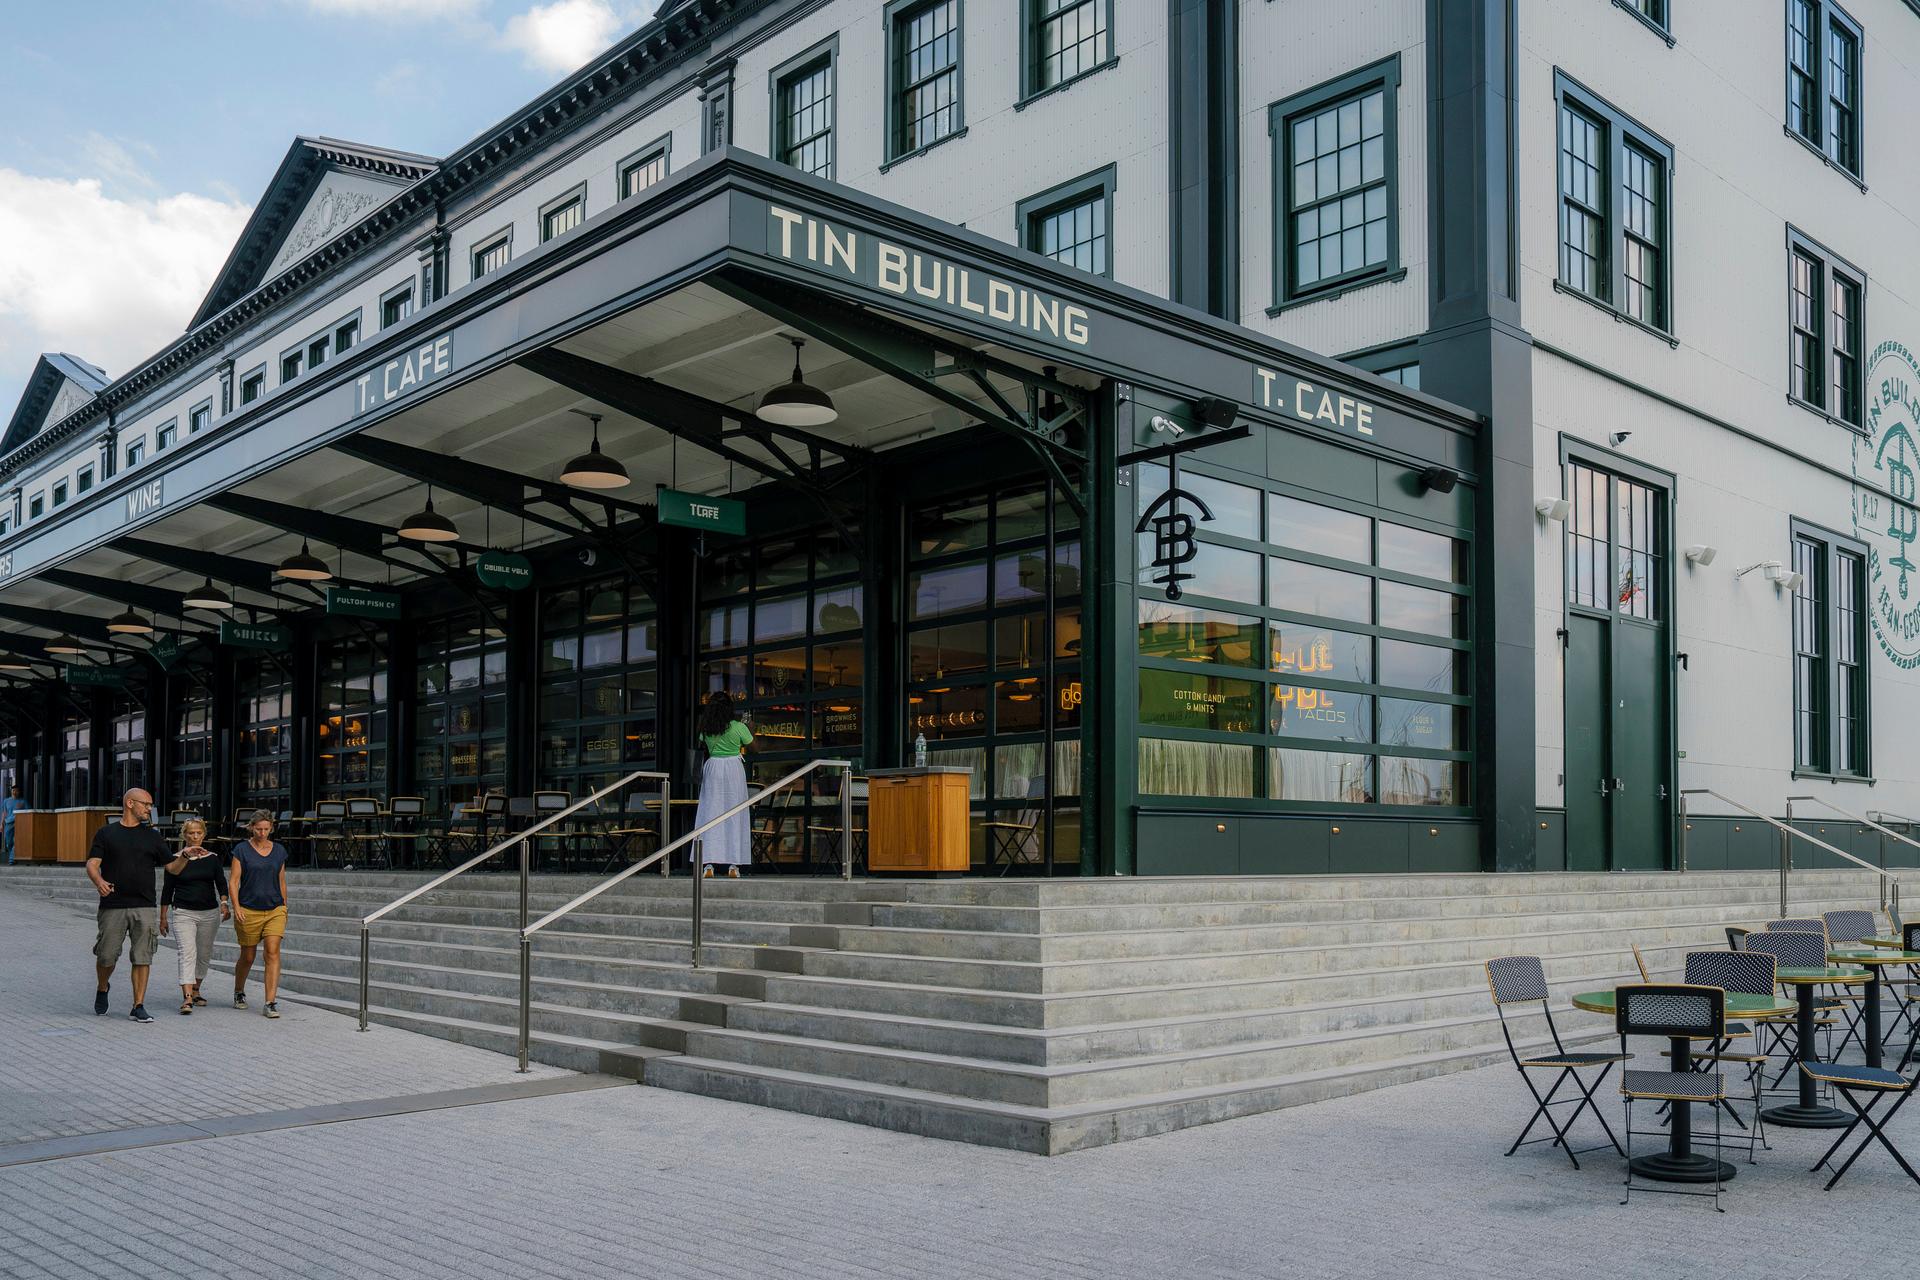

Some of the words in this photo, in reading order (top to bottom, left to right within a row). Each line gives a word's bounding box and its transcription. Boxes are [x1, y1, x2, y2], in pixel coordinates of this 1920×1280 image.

[771, 206, 856, 274] TIN
[879, 242, 1088, 345] BUILDING
[358, 374, 375, 412] T.
[384, 336, 449, 400] CAFE
[1258, 368, 1283, 407] T.
[1296, 382, 1373, 436] CAFE
[128, 480, 161, 519] WINE
[484, 563, 510, 574] DOUBLE
[511, 567, 529, 576] YOLK
[336, 597, 365, 606] FULTON
[367, 600, 384, 608] FISH
[1174, 689, 1202, 701] COTTON
[1203, 693, 1226, 704] CANDY
[1186, 702, 1191, 711] &
[1193, 703, 1215, 714] MINTS
[1297, 706, 1346, 724] TACOS
[825, 713, 857, 724] BROWNIES
[761, 721, 799, 736] BAKERY
[831, 723, 857, 733] COOKIES
[586, 738, 617, 751] EGGS
